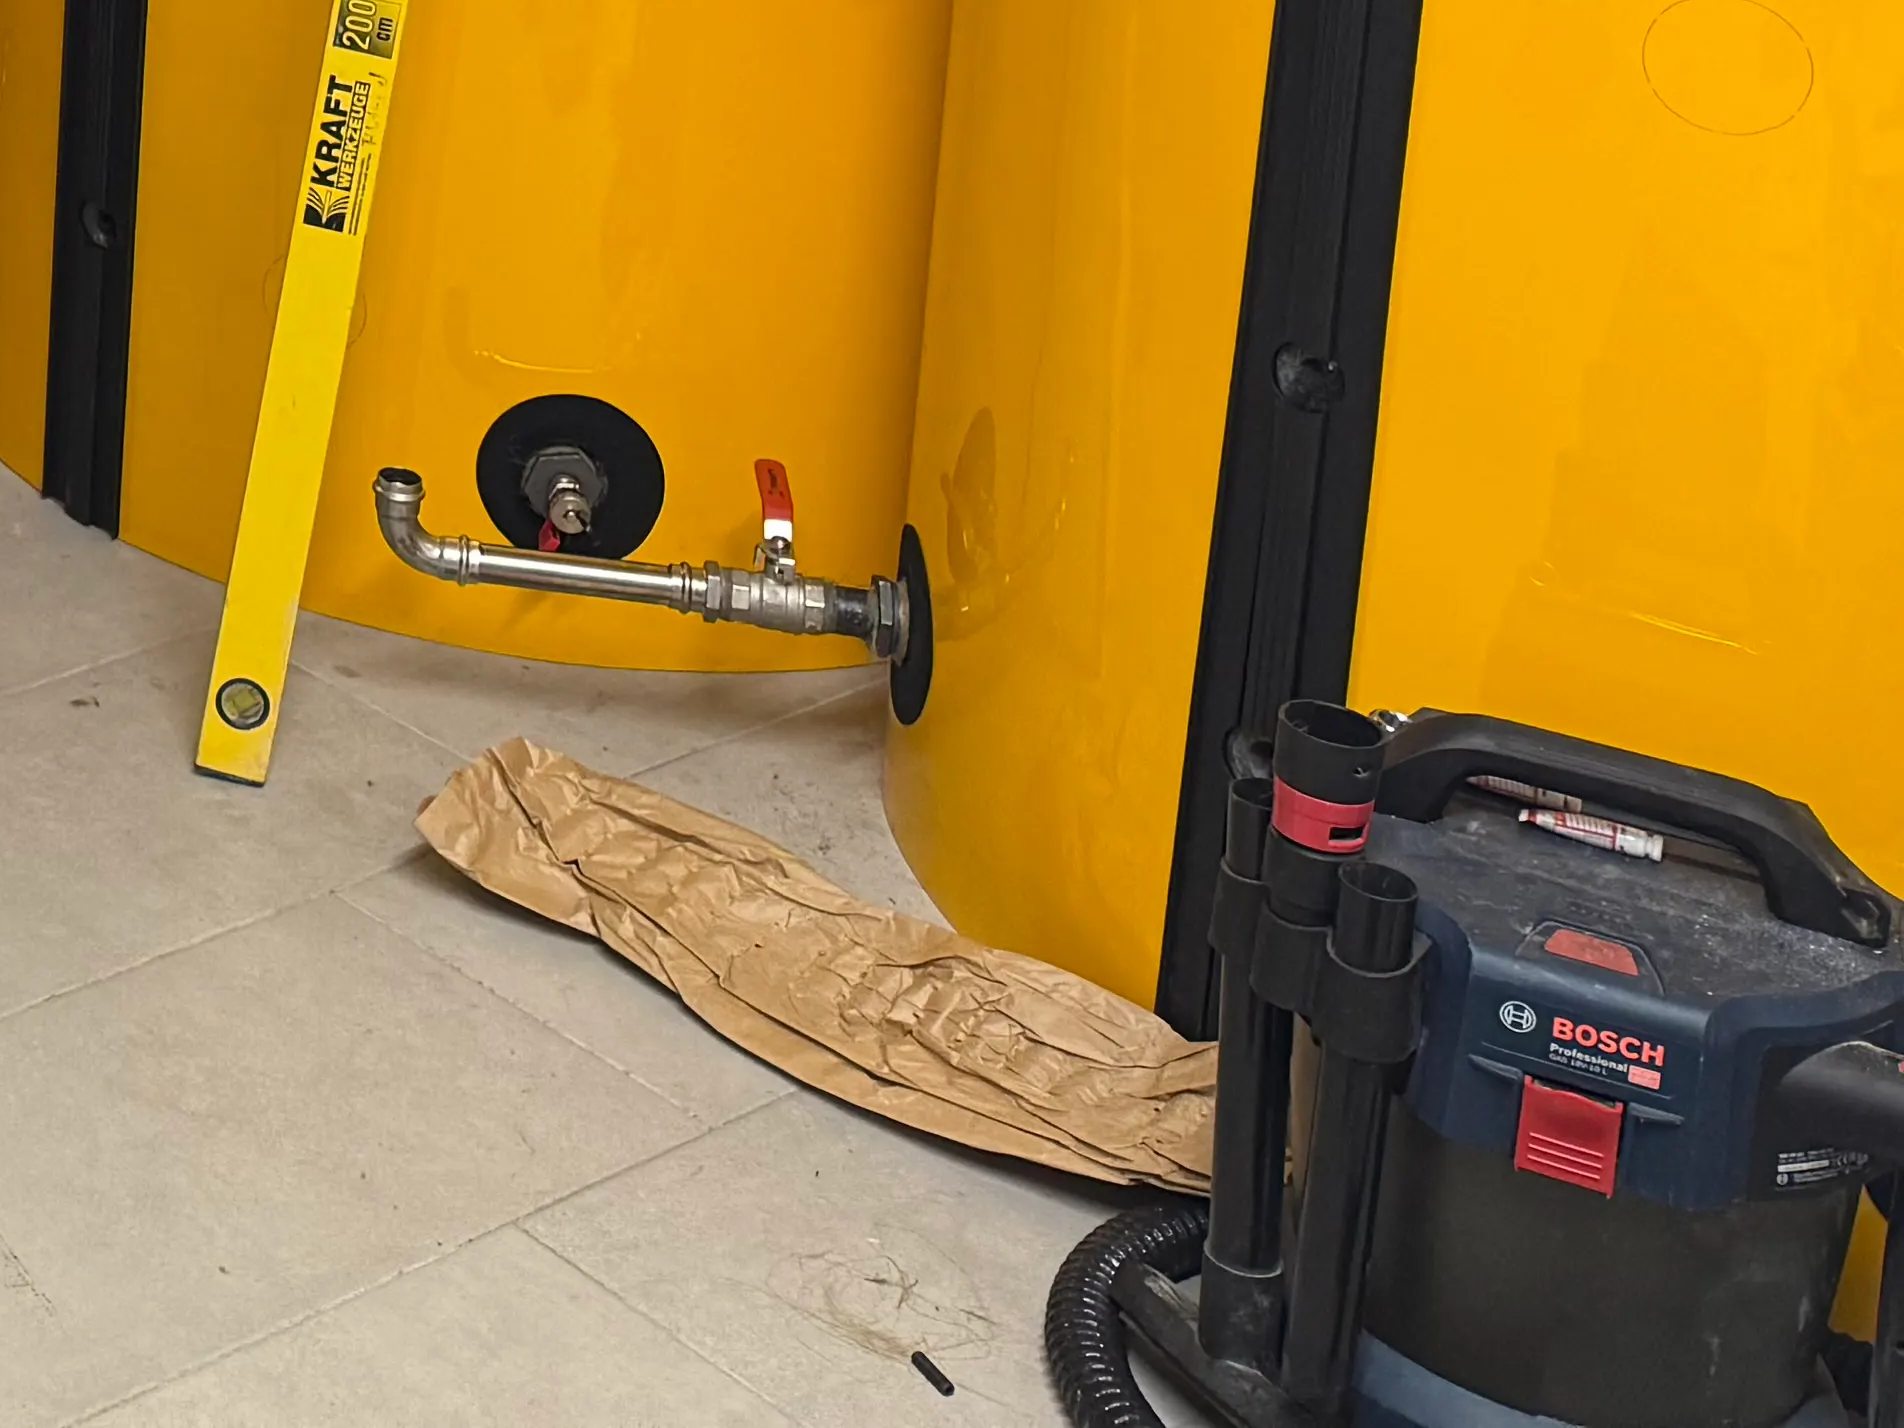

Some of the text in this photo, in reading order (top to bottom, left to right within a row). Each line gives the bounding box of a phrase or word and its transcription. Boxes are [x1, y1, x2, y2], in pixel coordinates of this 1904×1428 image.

[375, 17, 394, 42] cm
[310, 74, 354, 189] KRAFT
[337, 82, 371, 190] WERKZEUGE
[1549, 1042, 1628, 1073] Professional
[1552, 1016, 1665, 1067] BOSCH
